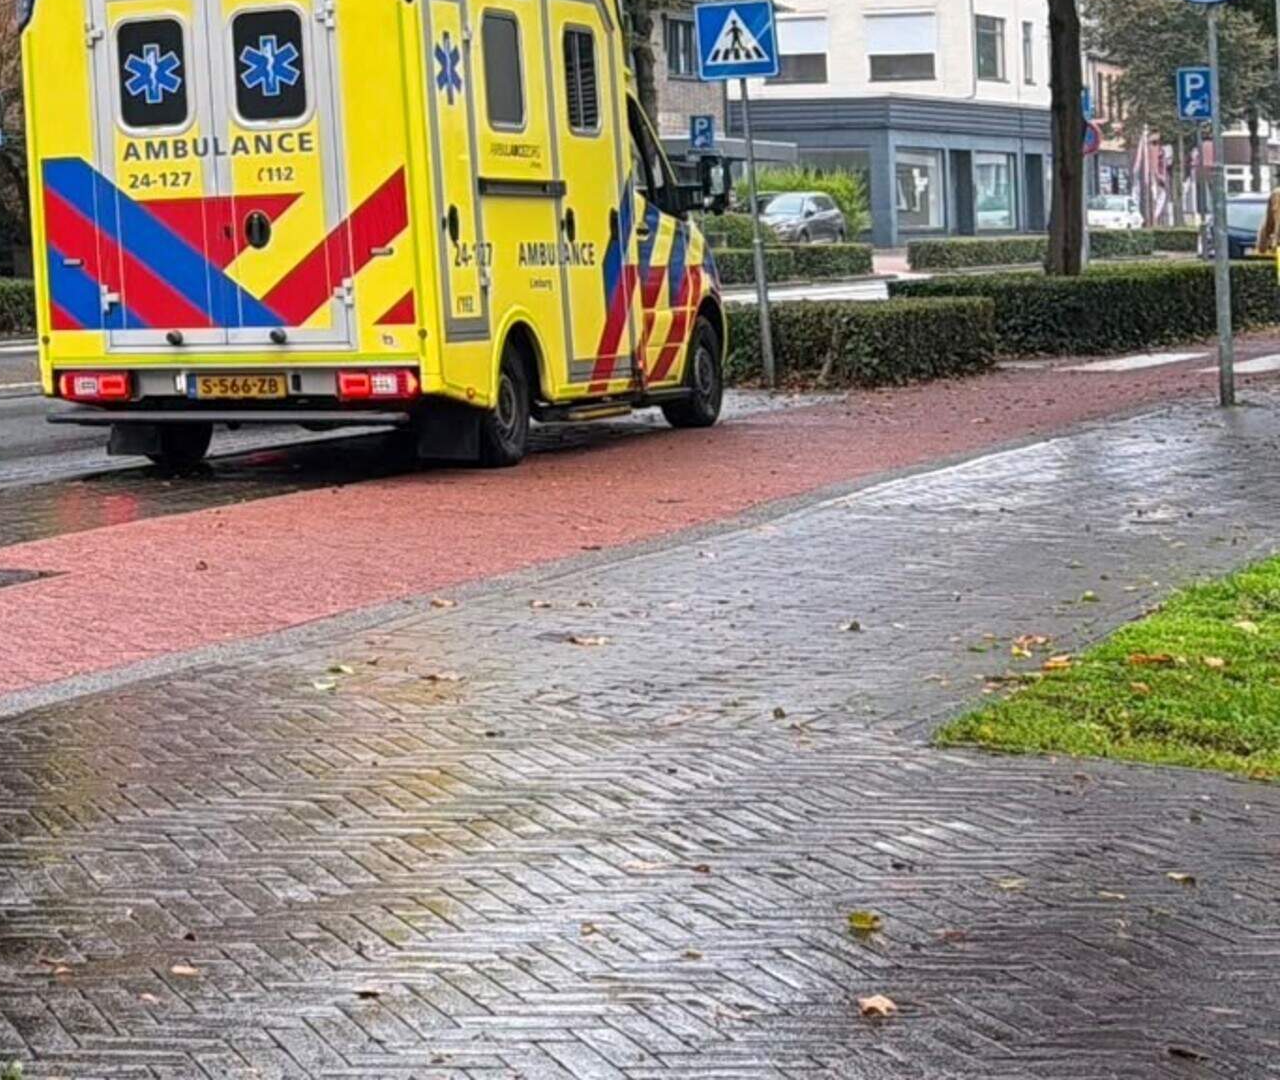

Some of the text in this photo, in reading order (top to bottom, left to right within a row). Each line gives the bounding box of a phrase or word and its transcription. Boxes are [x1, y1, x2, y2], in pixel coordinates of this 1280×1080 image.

[1186, 73, 1204, 98] P
[695, 118, 708, 137] P
[123, 132, 313, 161] AMBULANCE
[129, 172, 192, 189] 24-127
[518, 242, 595, 266] AMBULANCE
[202, 378, 279, 394] S-566-ZB
